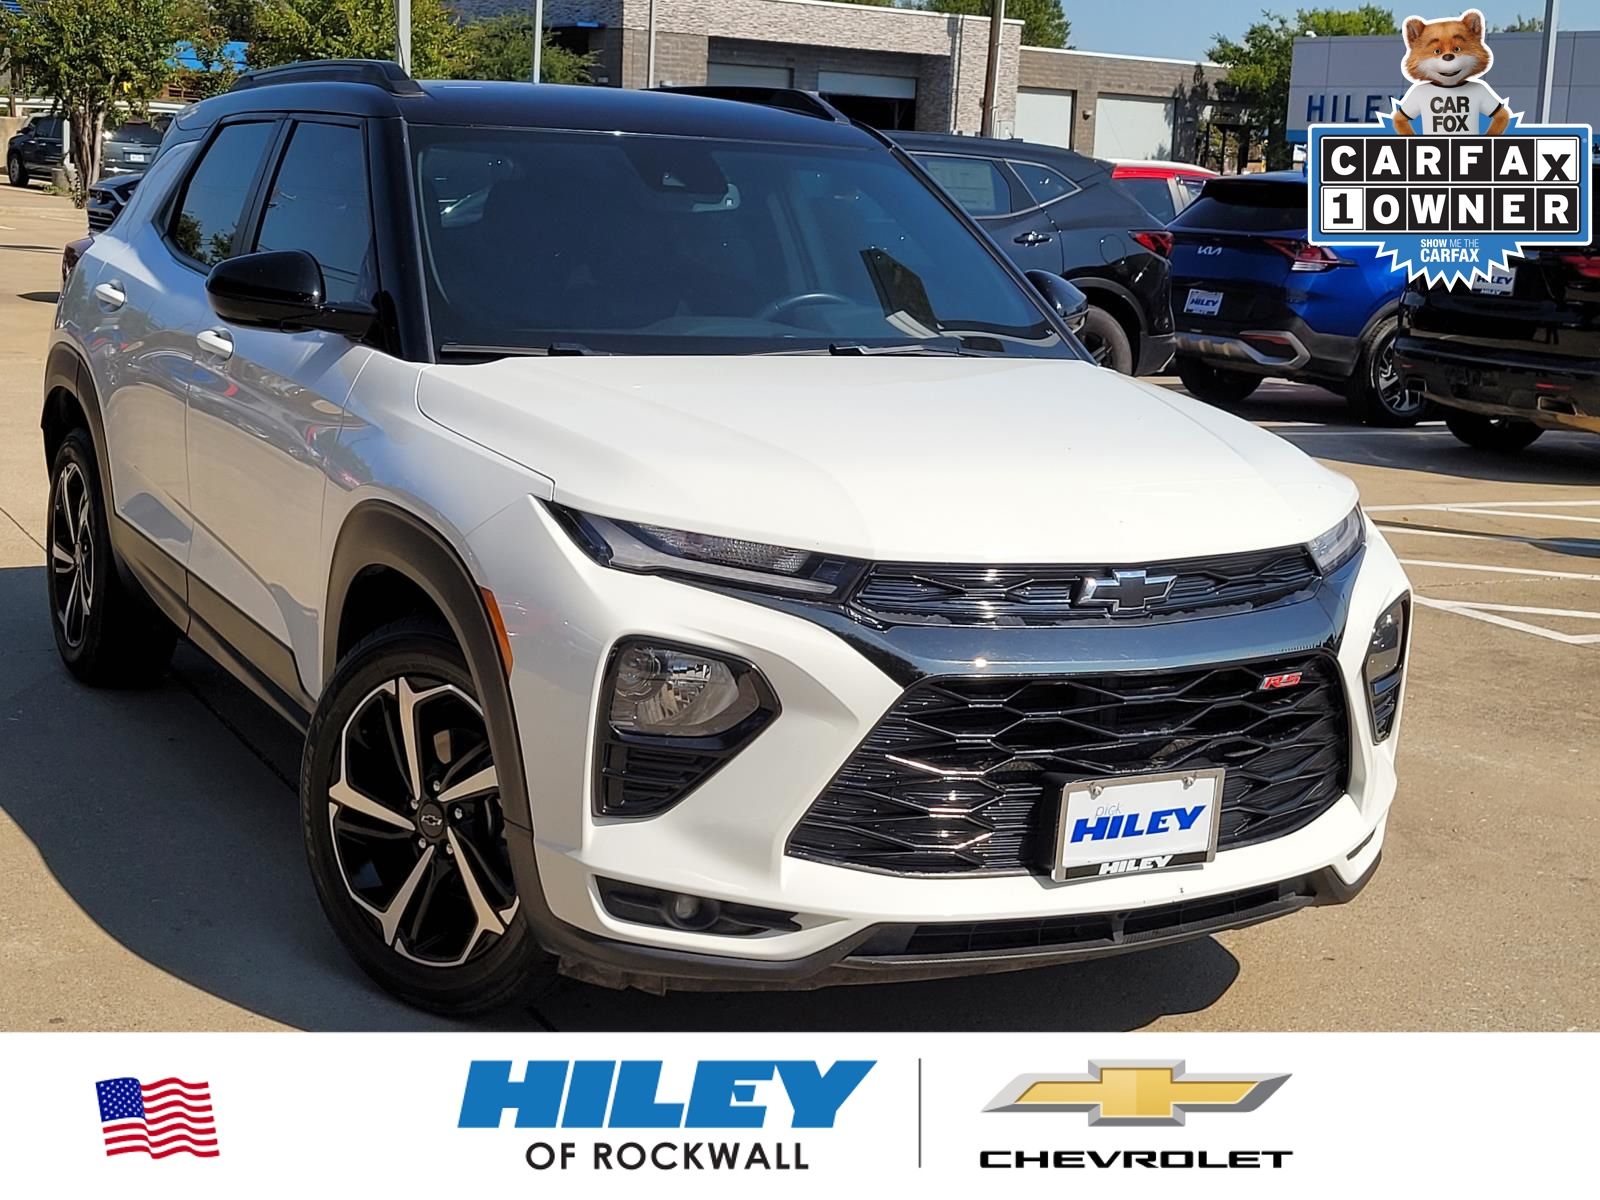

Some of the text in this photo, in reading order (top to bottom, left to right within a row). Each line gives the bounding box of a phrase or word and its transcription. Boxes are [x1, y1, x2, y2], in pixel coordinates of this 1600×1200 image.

[1306, 95, 1405, 123] HILE
[1260, 672, 1302, 690] RS
[1070, 805, 1207, 844] HILEY
[1098, 855, 1174, 876] HILEY
